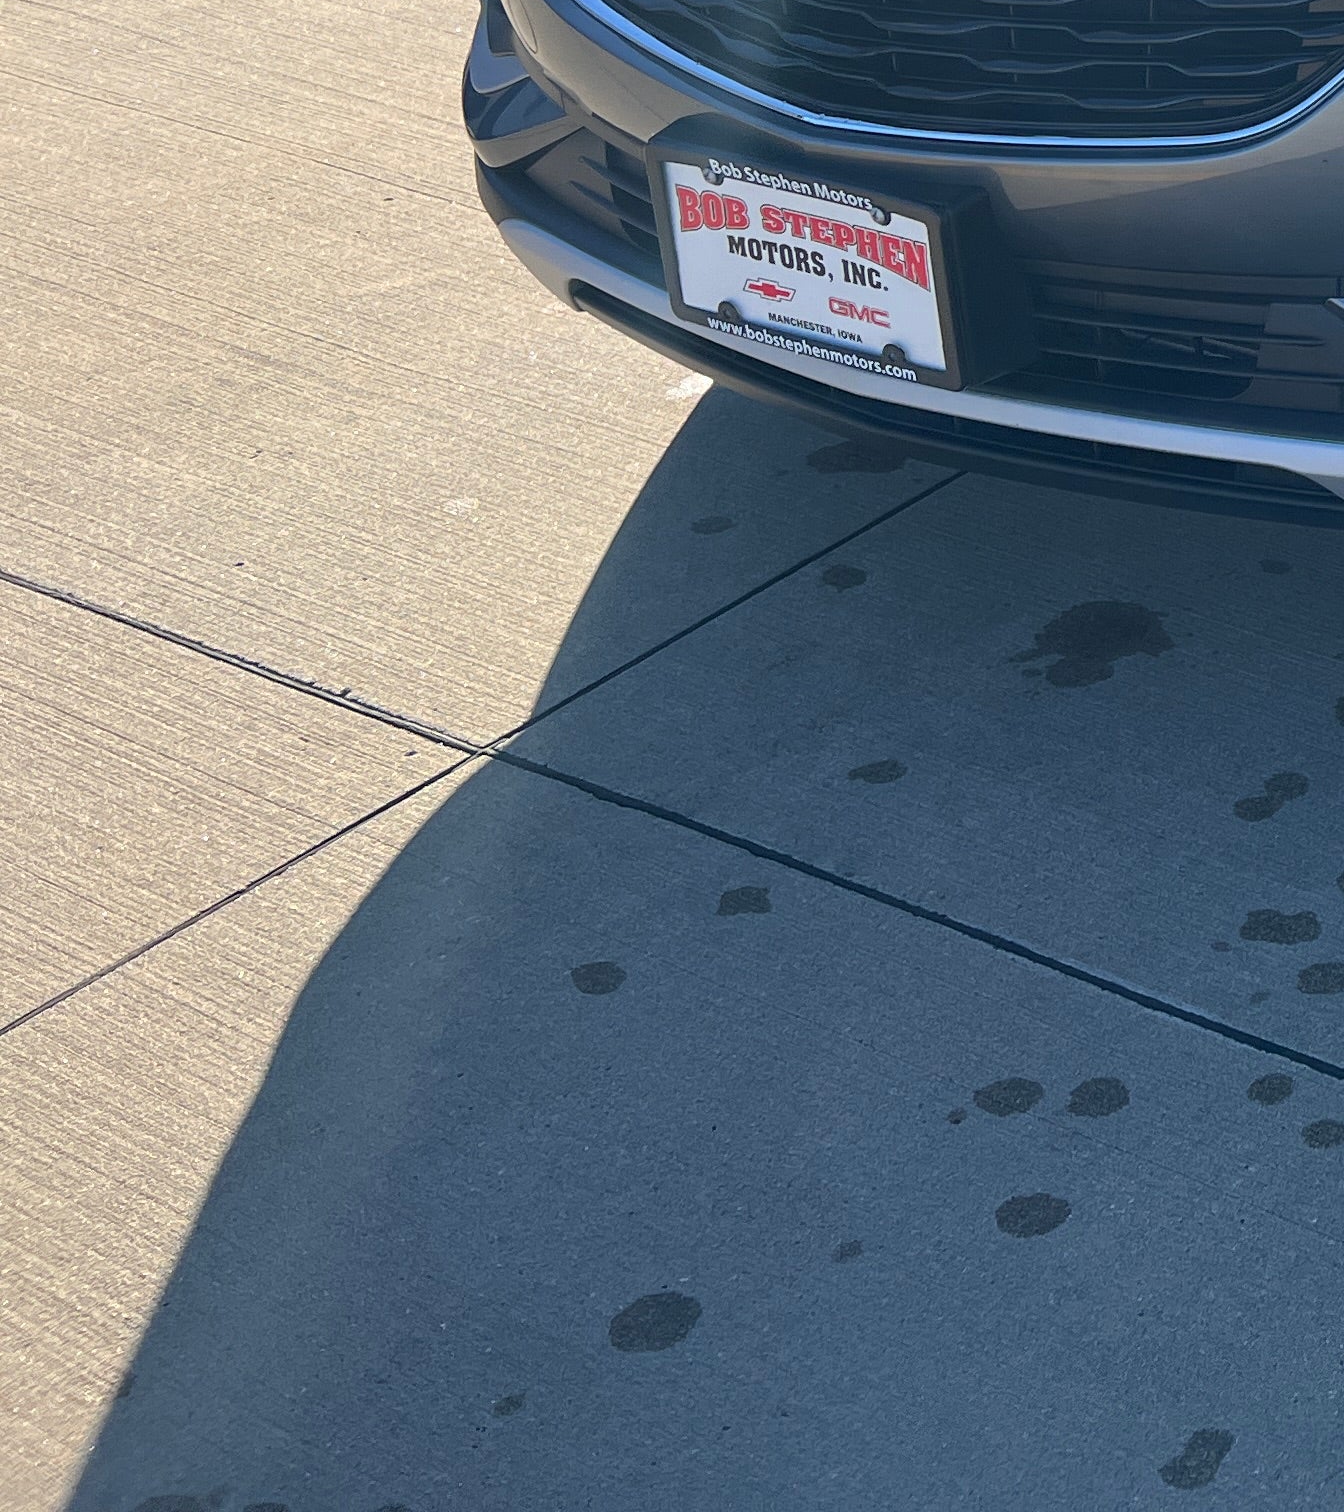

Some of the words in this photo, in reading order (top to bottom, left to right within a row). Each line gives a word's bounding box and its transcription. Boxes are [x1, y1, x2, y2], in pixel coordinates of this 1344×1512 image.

[708, 158, 742, 180] Bob
[743, 166, 812, 196] Stephen
[813, 182, 873, 209] Motors
[675, 184, 749, 232] BOB
[760, 204, 931, 292] STEPHEN
[727, 235, 834, 282] MOTORS,
[841, 259, 889, 291] INC.
[768, 312, 836, 338] MANCHESTER,
[837, 329, 863, 344] IOWA
[828, 296, 891, 329] GMC
[707, 316, 917, 382] www.bobstephenmotors.com
